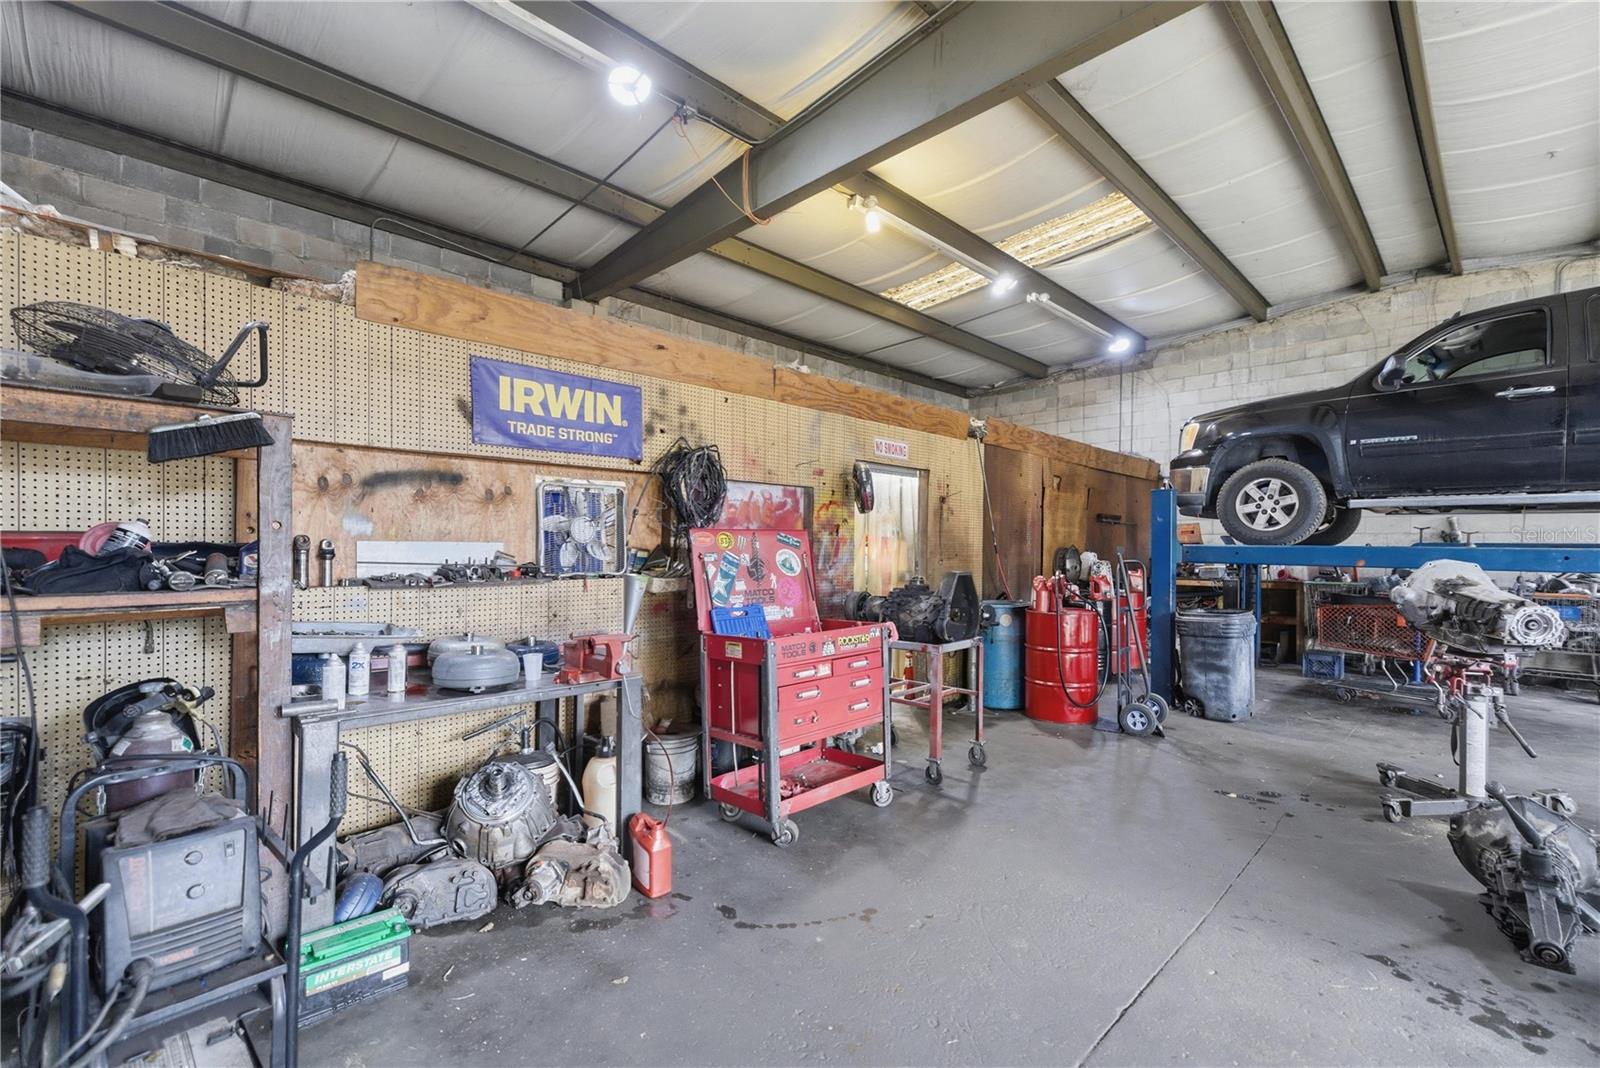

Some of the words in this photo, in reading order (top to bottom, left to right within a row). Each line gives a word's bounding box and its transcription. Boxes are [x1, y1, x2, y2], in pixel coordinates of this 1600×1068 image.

[499, 376, 622, 427] IRWIN
[507, 420, 555, 439] TRADE
[558, 427, 613, 444] STRONG
[876, 440, 883, 453] NO
[885, 443, 906, 457] SMOKING
[744, 588, 774, 596] MATCO
[781, 642, 807, 652] MATCO
[782, 649, 807, 659] TOOLS
[314, 949, 393, 985] INTERSTATE
